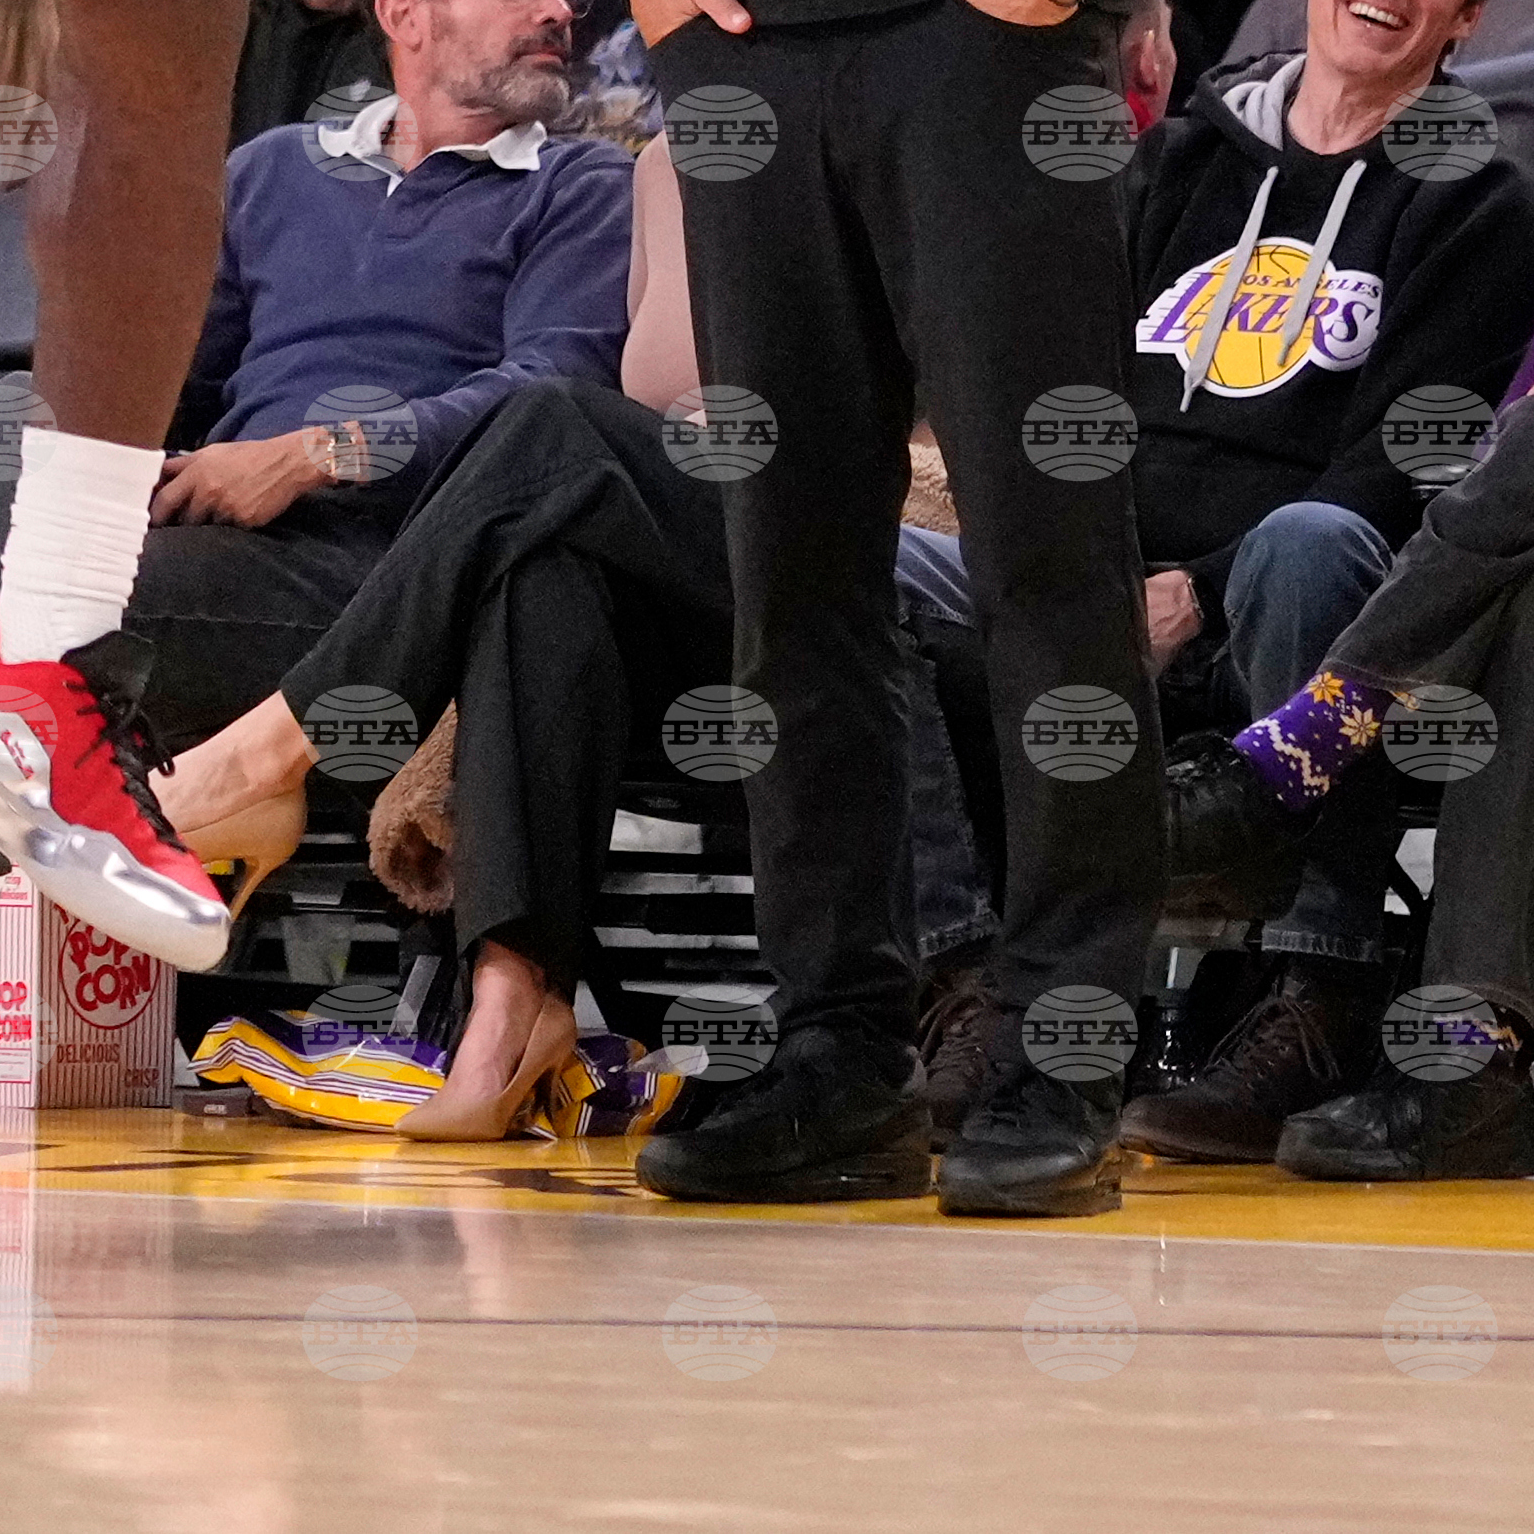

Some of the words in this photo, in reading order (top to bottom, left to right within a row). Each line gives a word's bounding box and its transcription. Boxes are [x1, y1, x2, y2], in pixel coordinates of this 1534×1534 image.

[1240, 274, 1272, 287] OS
[1272, 276, 1384, 299] AELES
[75, 953, 151, 1012] CORN
[56, 1043, 121, 1064] DELICIOUS
[123, 1067, 160, 1088] CRISP
